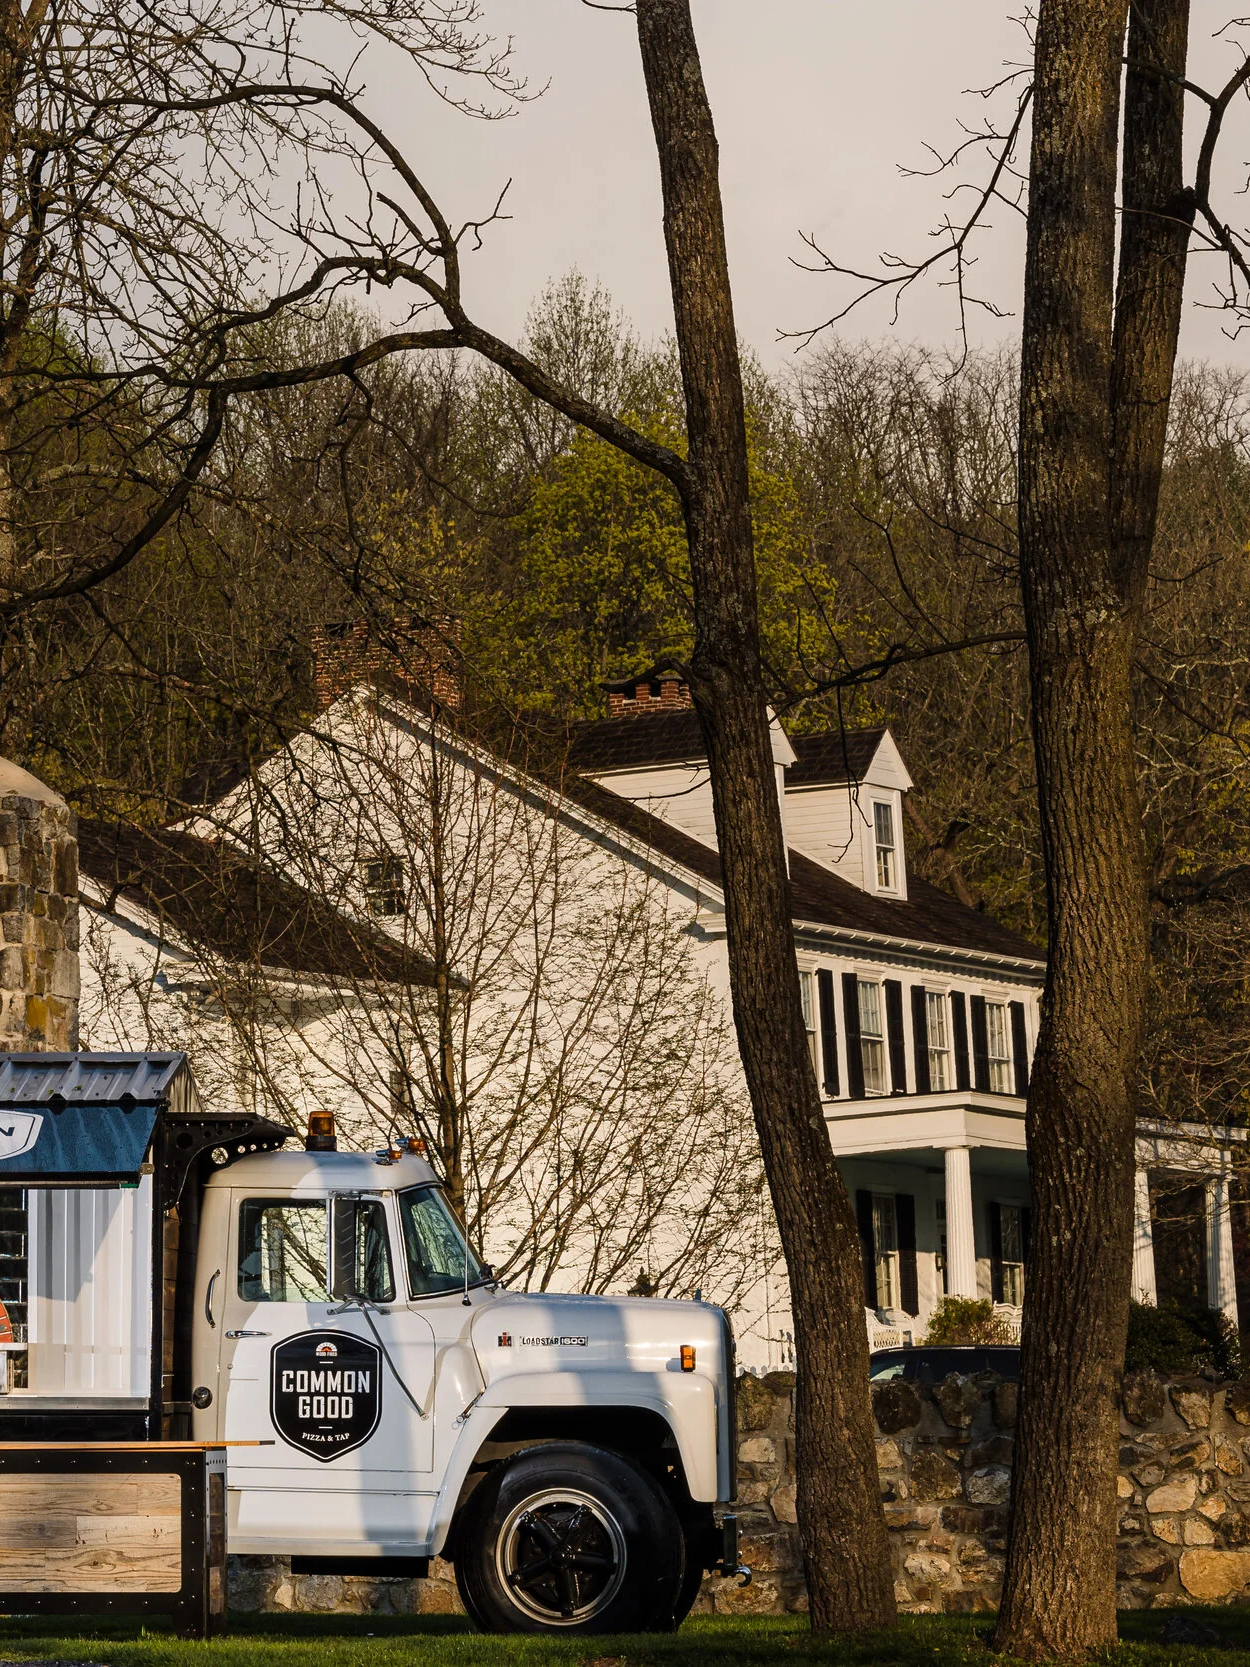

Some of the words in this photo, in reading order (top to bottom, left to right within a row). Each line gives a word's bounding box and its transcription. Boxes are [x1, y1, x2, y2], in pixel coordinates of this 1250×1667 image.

[522, 1337, 559, 1346] LOADSTAR
[282, 1370, 370, 1393] COMMON
[298, 1396, 353, 1418] GOOD
[301, 1432, 326, 1442] PIZZA
[334, 1432, 350, 1441] TAP
